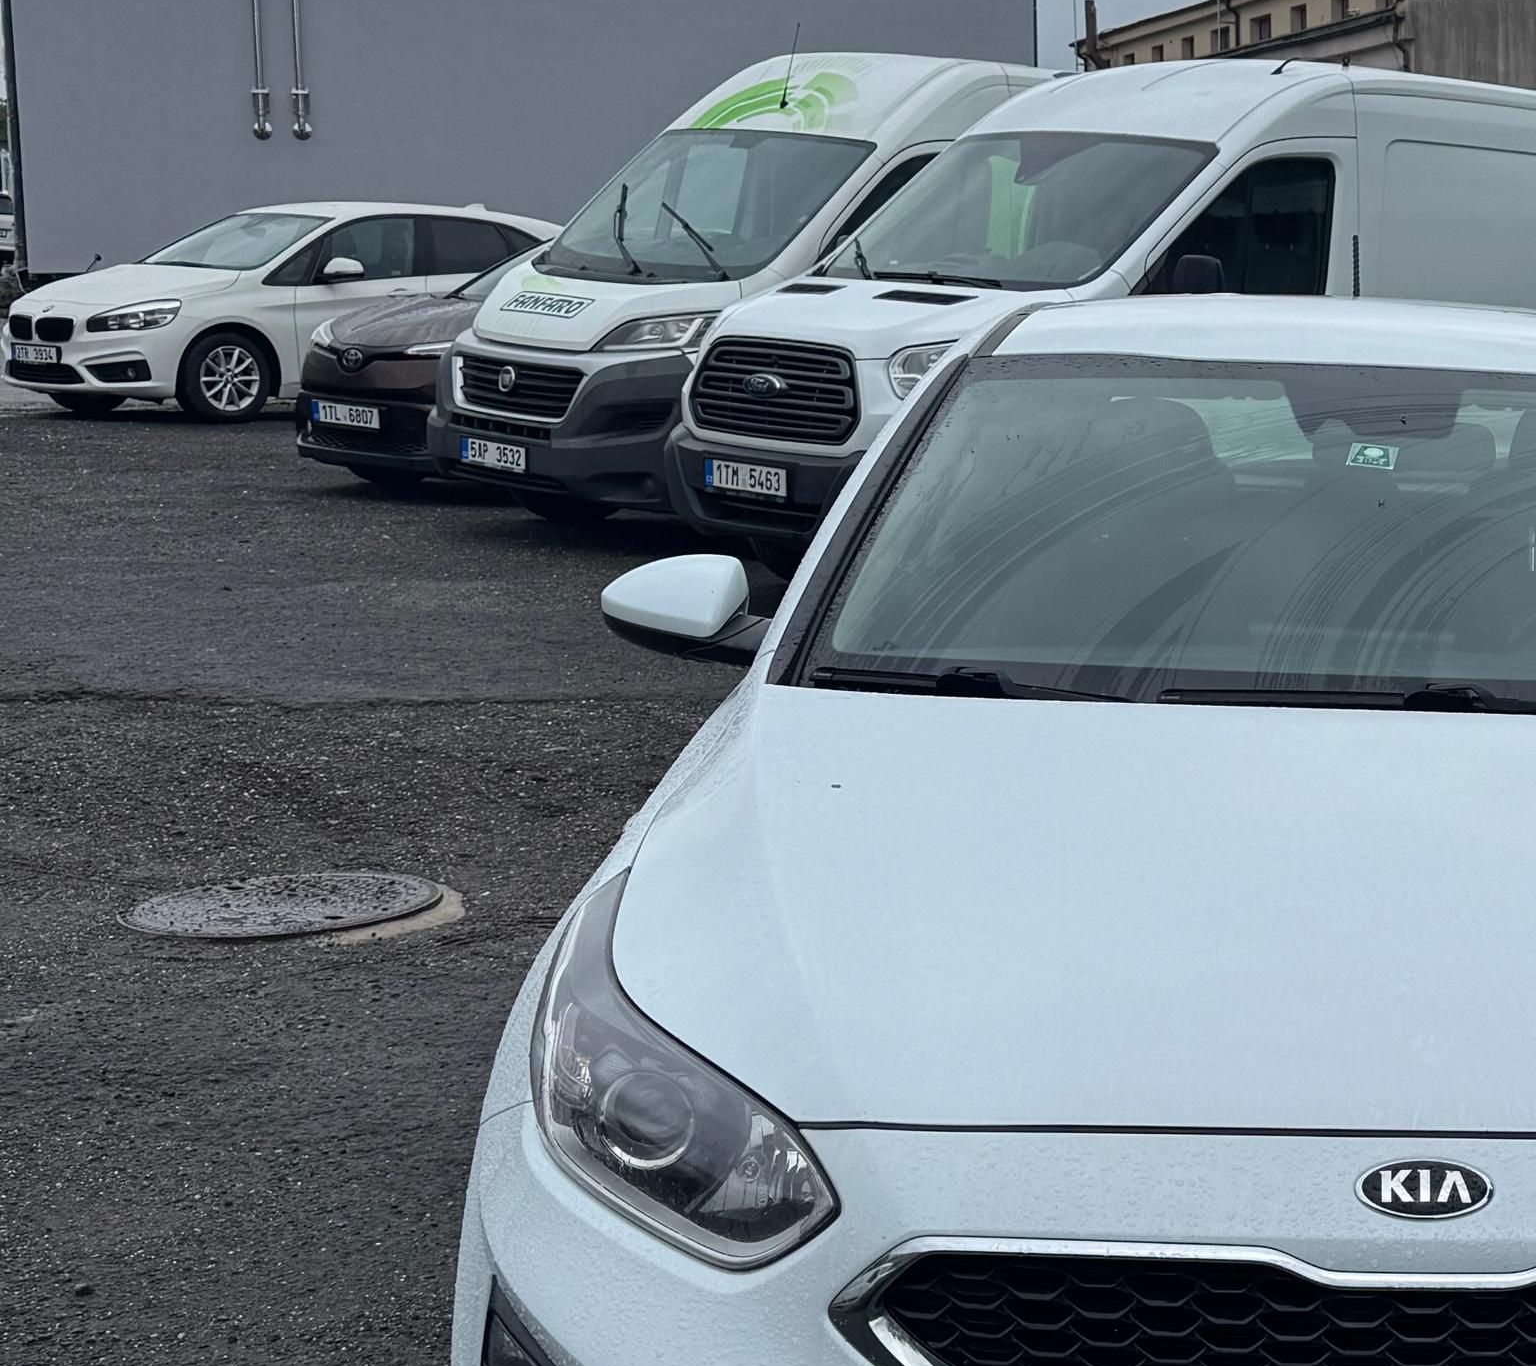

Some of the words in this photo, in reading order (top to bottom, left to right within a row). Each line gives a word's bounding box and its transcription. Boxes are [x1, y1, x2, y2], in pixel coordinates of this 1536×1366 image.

[506, 294, 585, 314] FANFARO
[322, 404, 341, 421] 1TL
[348, 407, 374, 425] 6807
[470, 440, 489, 460] 5AP
[496, 445, 522, 467] 3532
[717, 463, 739, 487] 1TM
[749, 468, 780, 492] 5463
[1379, 1169, 1472, 1204] KIA
